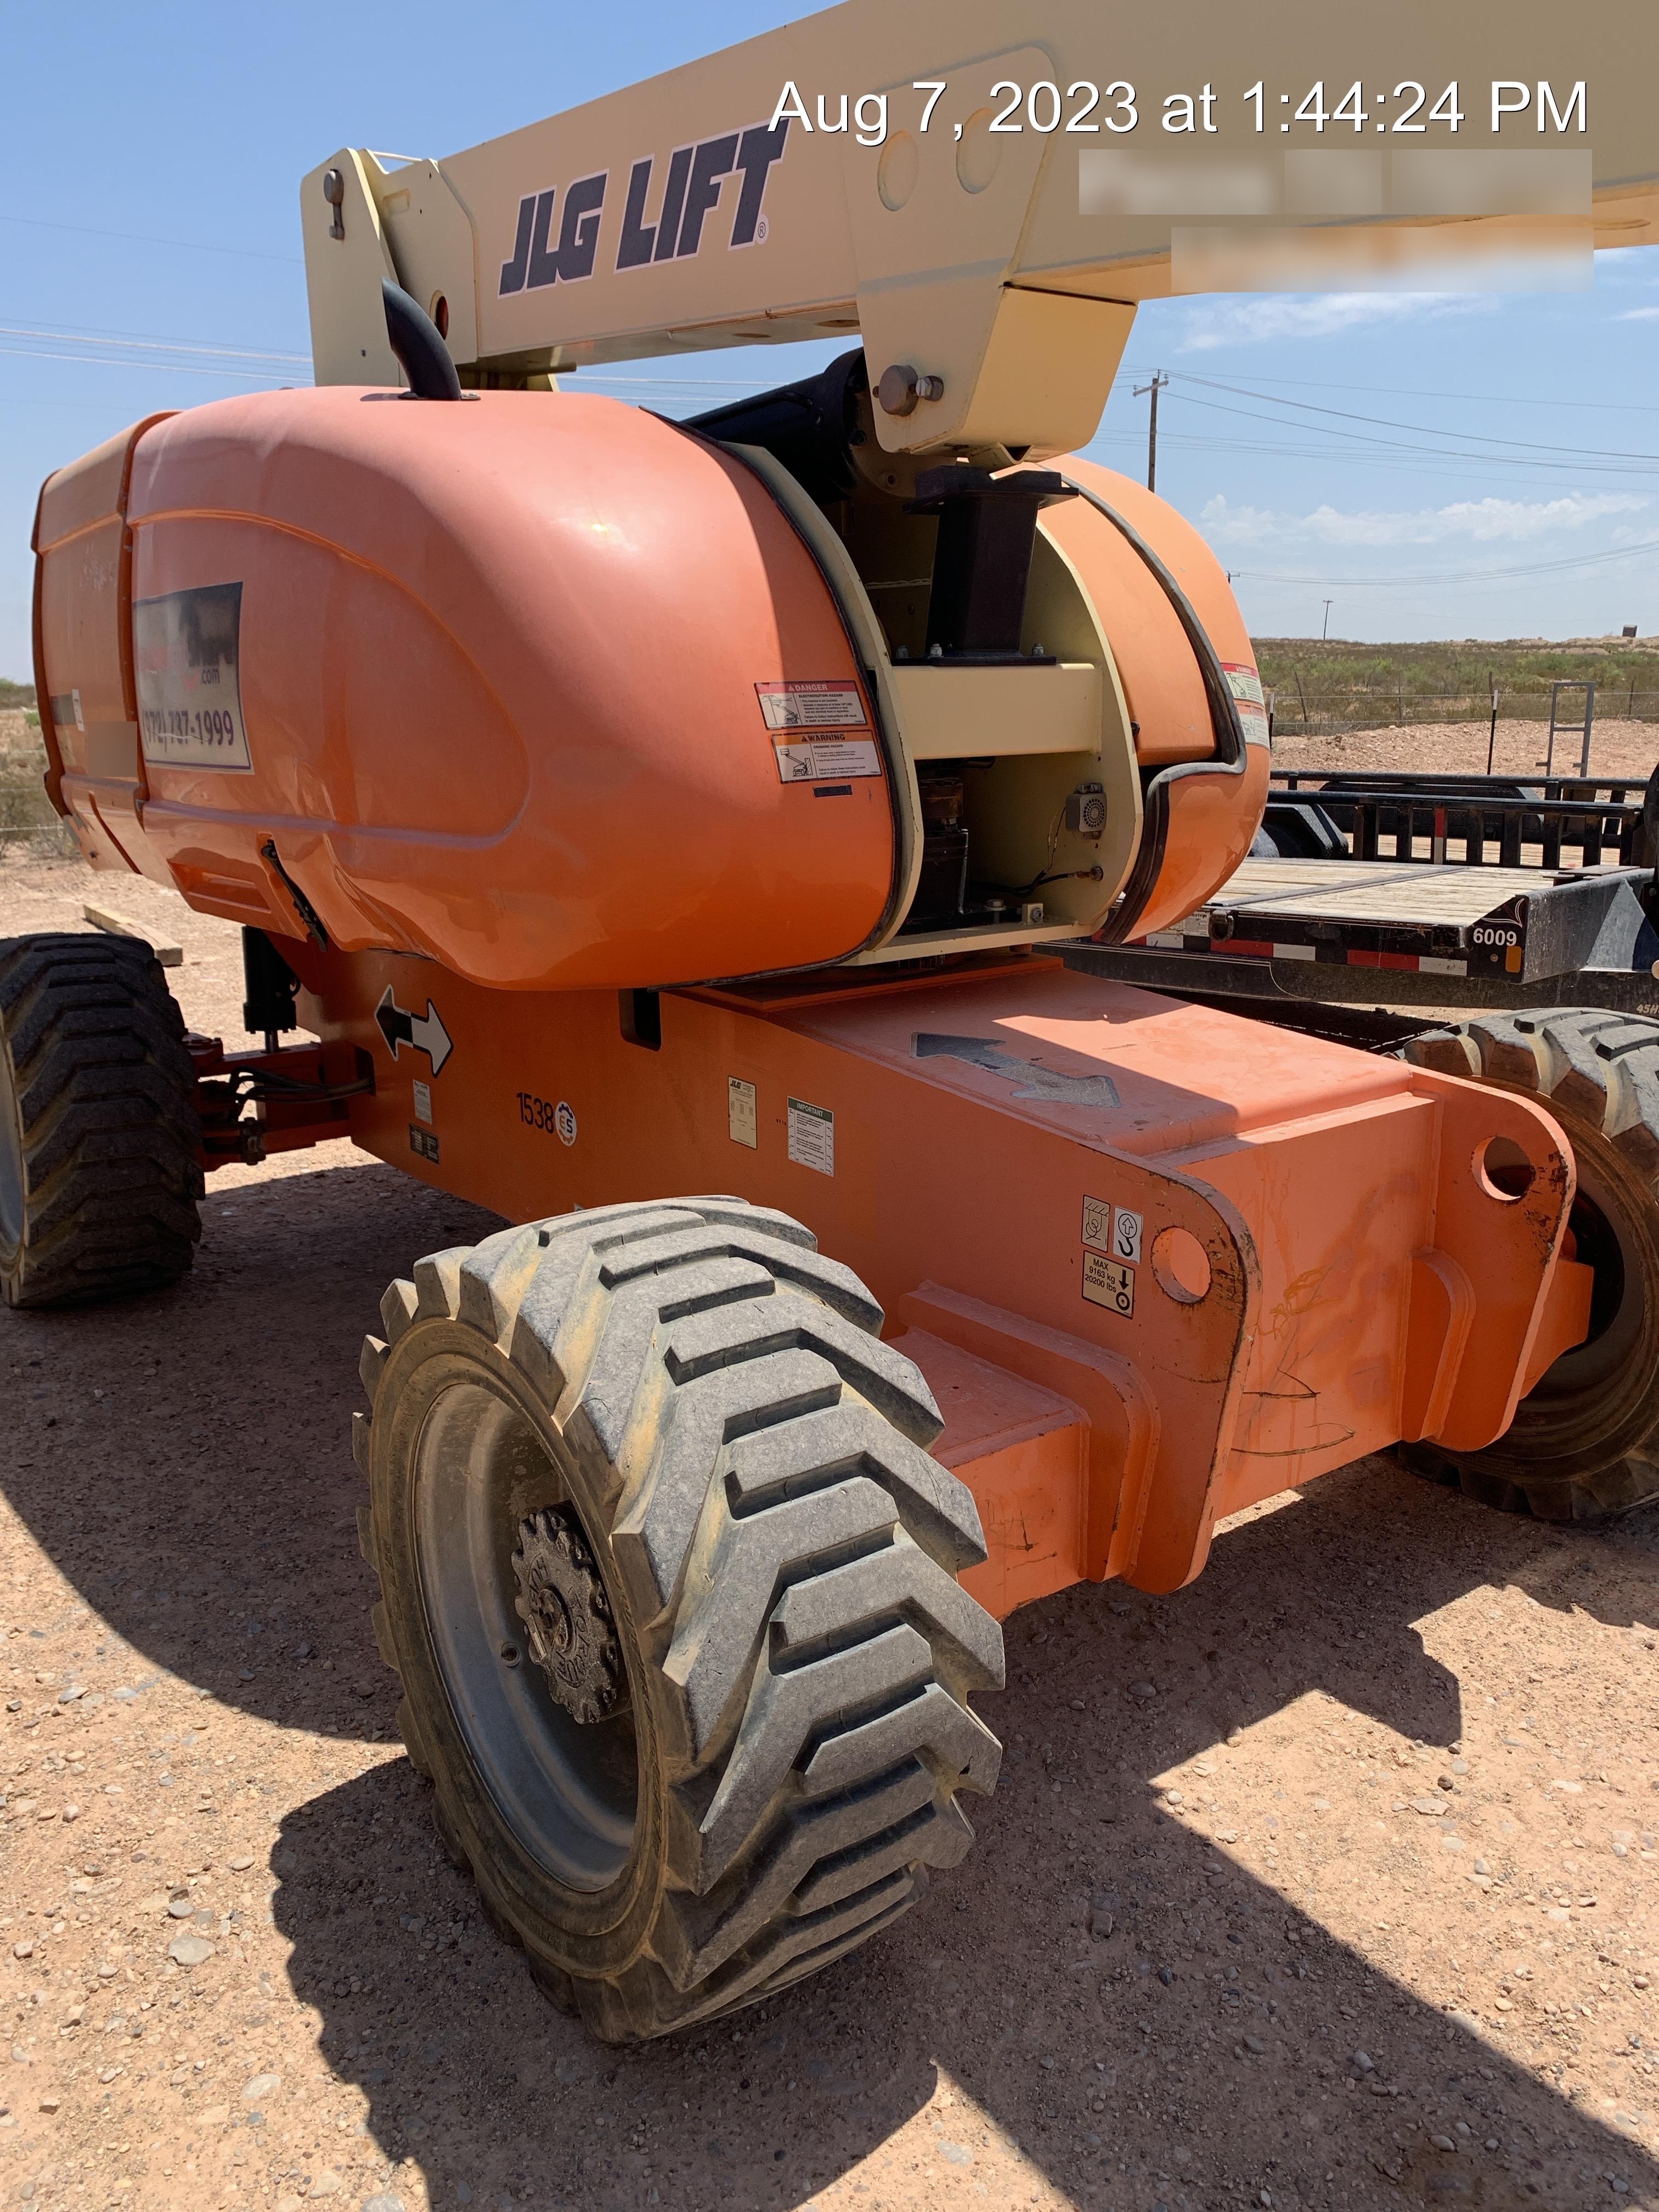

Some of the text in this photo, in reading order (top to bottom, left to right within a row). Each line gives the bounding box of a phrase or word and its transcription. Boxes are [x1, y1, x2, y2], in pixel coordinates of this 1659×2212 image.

[498, 117, 791, 300] JLG LIFT
[808, 733, 845, 742] WARNING
[1472, 927, 1517, 947] 6009
[516, 1092, 554, 1133] 1538
[796, 1101, 824, 1118] IMPORTANT
[1093, 1259, 1109, 1271] MAX
[1085, 1274, 1116, 1293] 20200 lbs
[1089, 1266, 1115, 1284] 9163 kg
